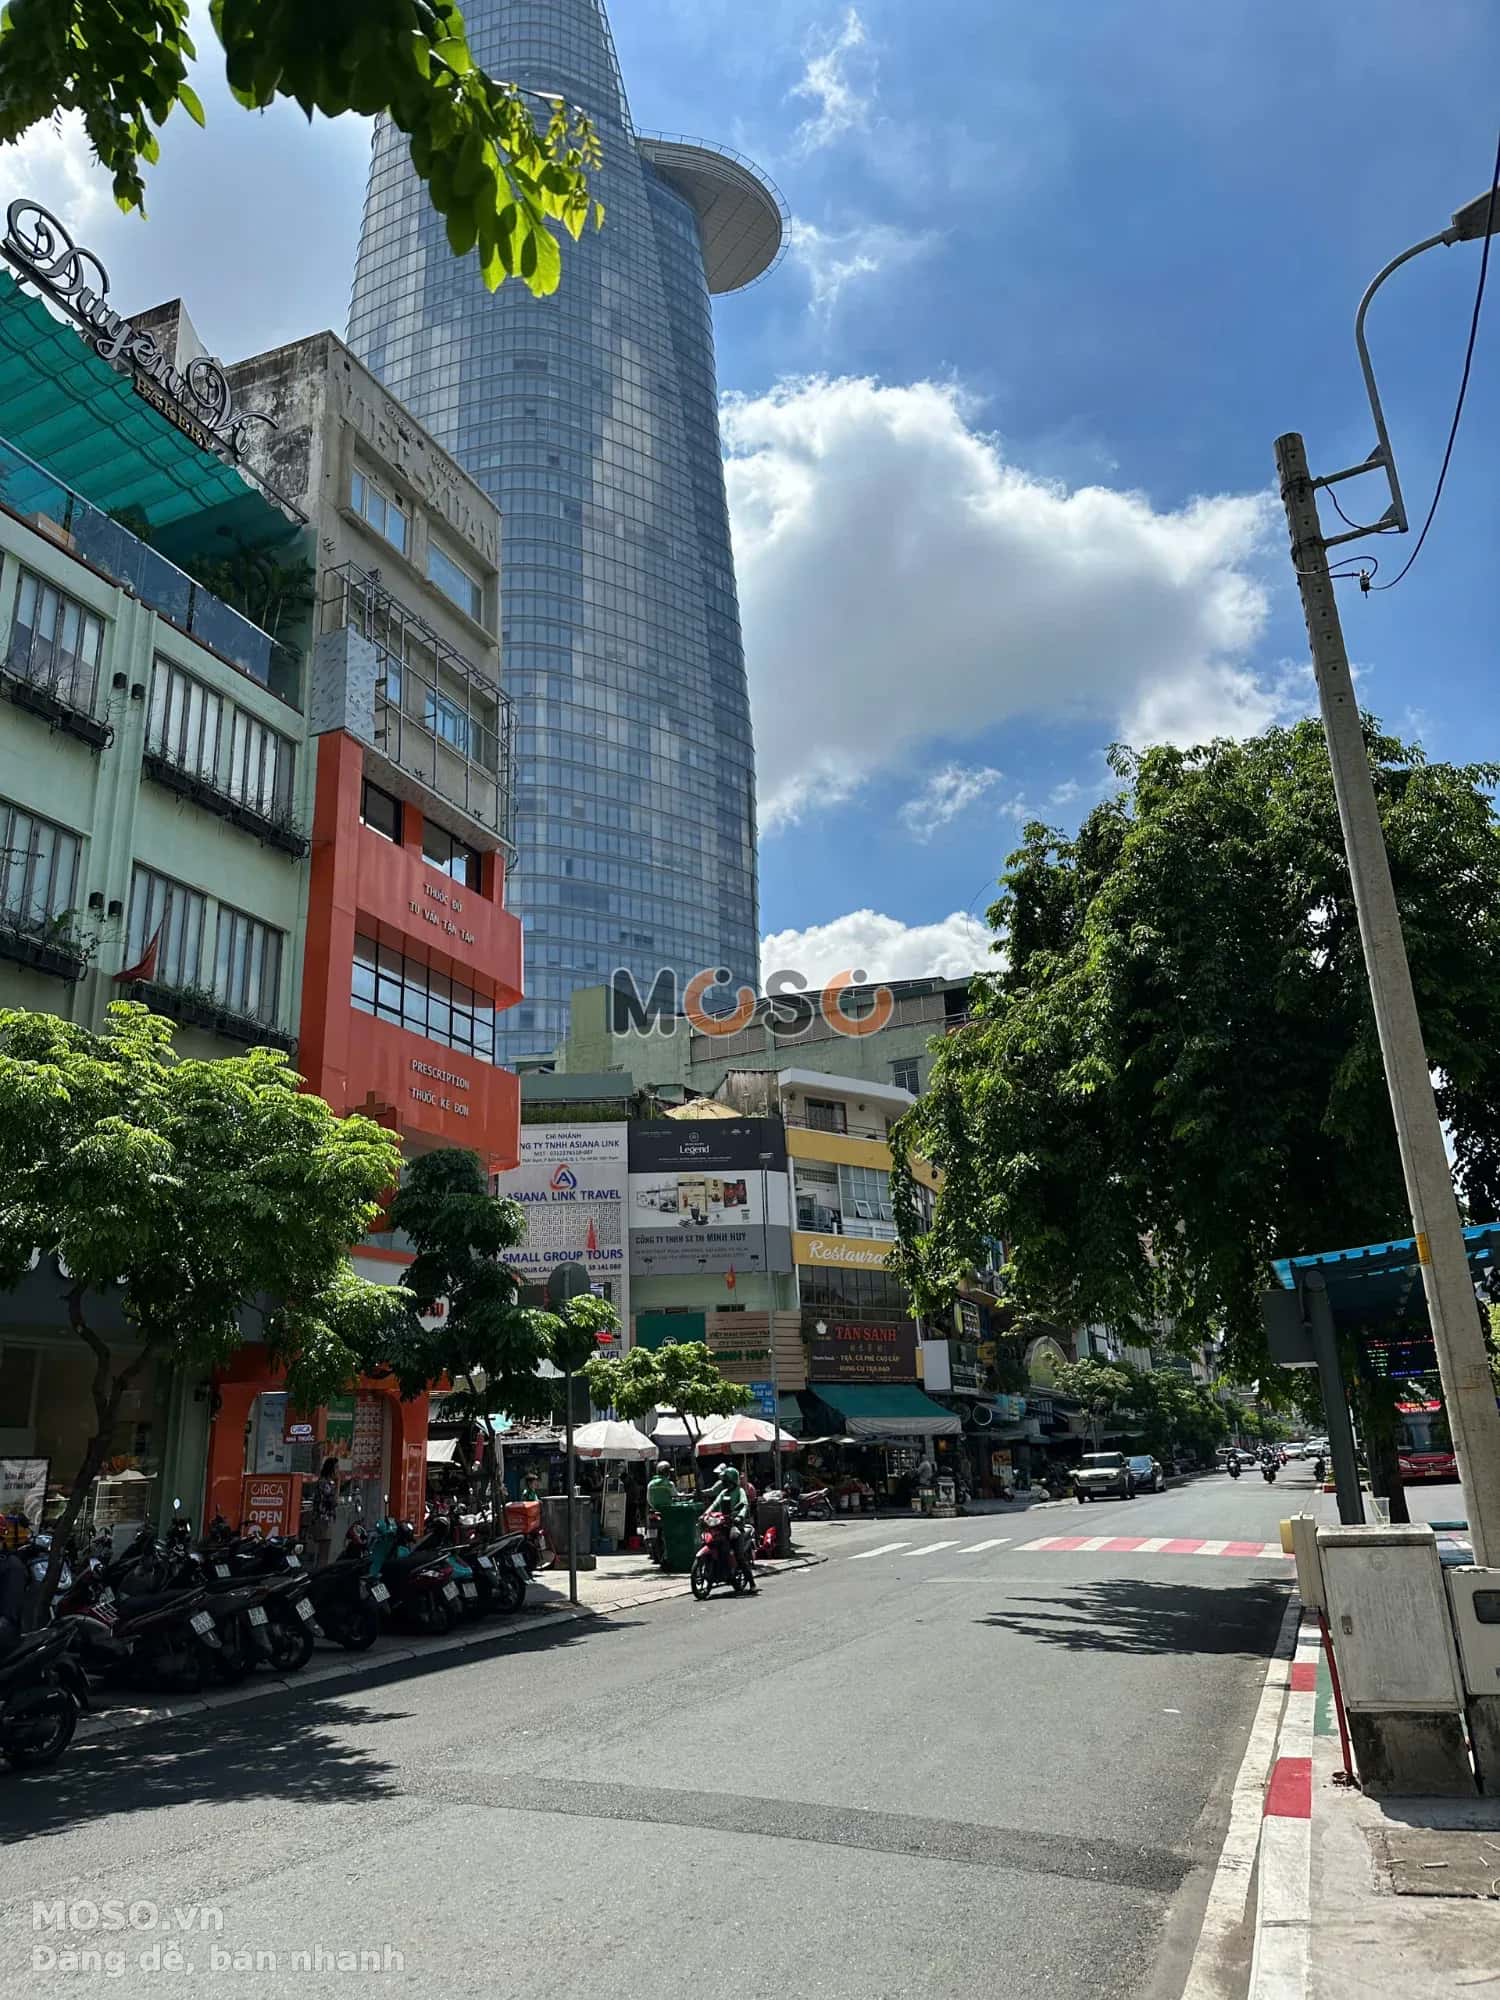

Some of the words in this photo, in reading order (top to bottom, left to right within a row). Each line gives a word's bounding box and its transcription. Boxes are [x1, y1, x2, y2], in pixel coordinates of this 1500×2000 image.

[412, 1059, 470, 1090] PRESCRIPTION
[569, 1141, 600, 1149] ASIANA
[601, 1140, 620, 1148] LINK
[679, 1145, 710, 1155] Legend
[507, 1192, 547, 1202] ASIANA
[552, 1191, 576, 1201] LINK
[580, 1189, 622, 1200] TRAVEL
[730, 1232, 746, 1241] HUY
[502, 1253, 541, 1263] SMALL
[543, 1251, 583, 1261] GROUP
[586, 1249, 624, 1259] TOURS
[808, 1239, 886, 1265] Restaura
[250, 1511, 283, 1524] OPEN
